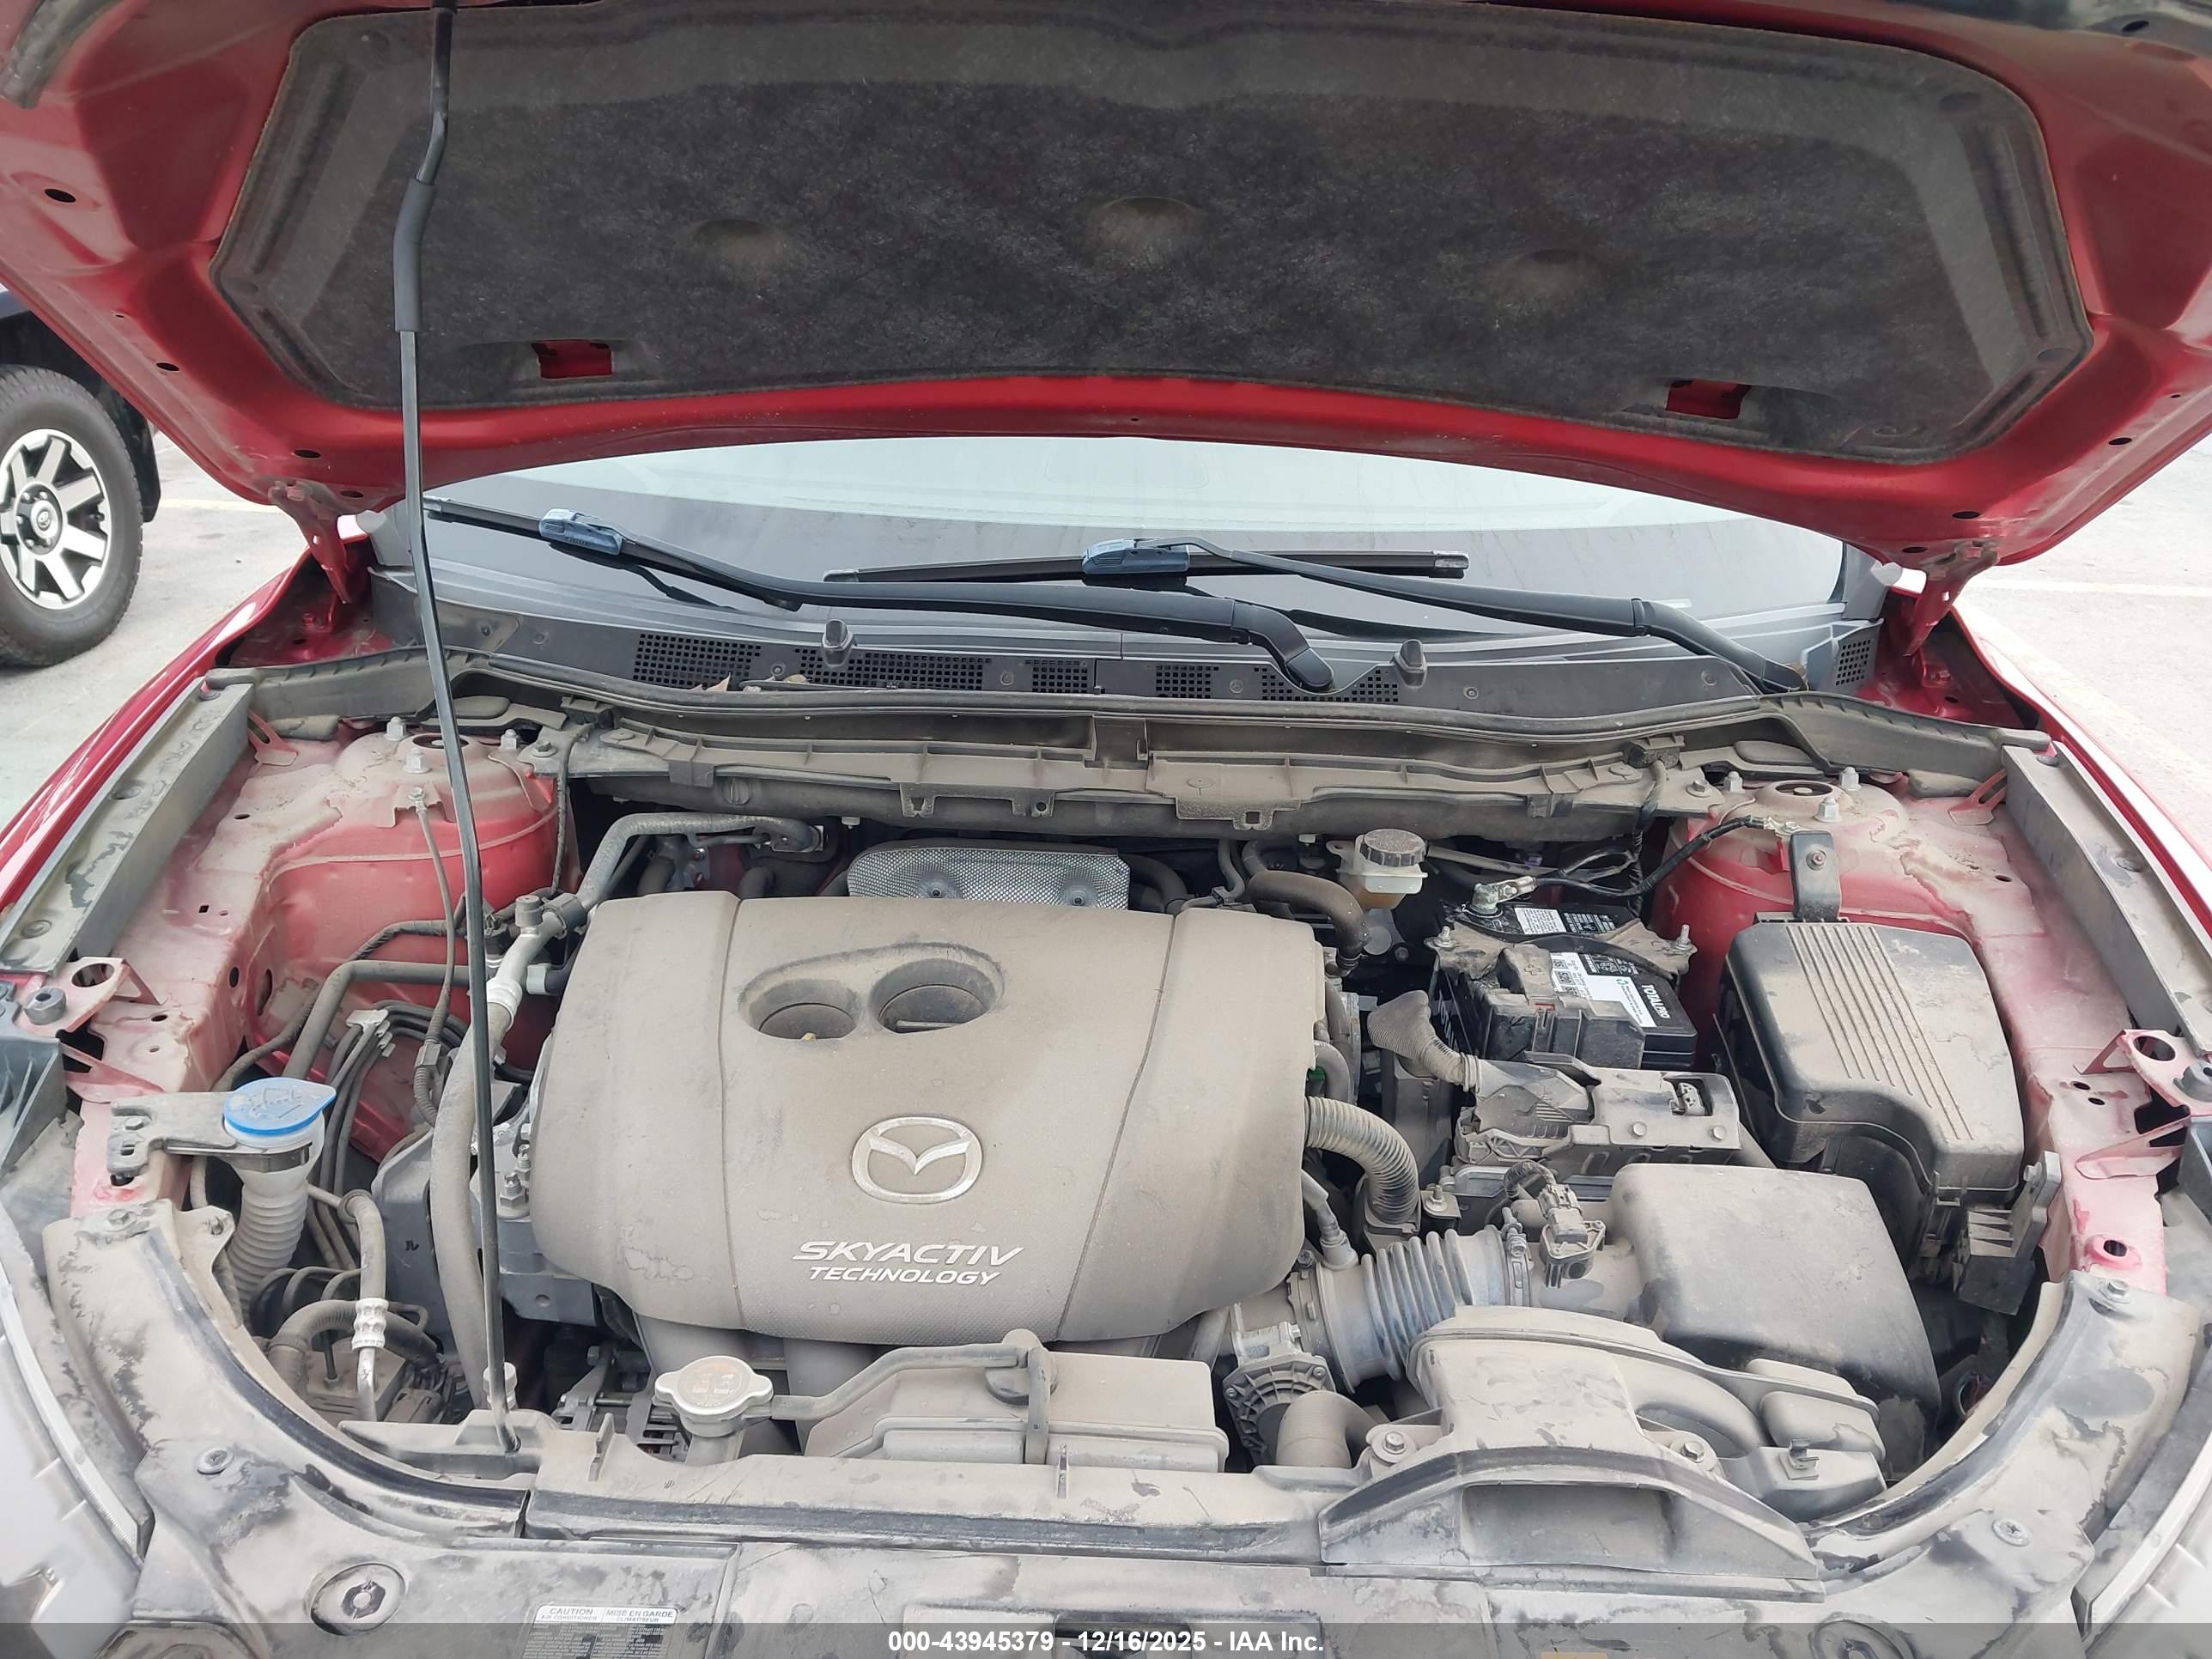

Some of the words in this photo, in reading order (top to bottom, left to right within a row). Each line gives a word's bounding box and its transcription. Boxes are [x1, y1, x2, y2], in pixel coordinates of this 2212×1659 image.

[1558, 971, 1571, 984] 520
[1642, 984, 1670, 1019] TOTALPRO
[792, 1241, 1026, 1266] SKYACTIV
[809, 1266, 1000, 1285] TECHNOLOGY
